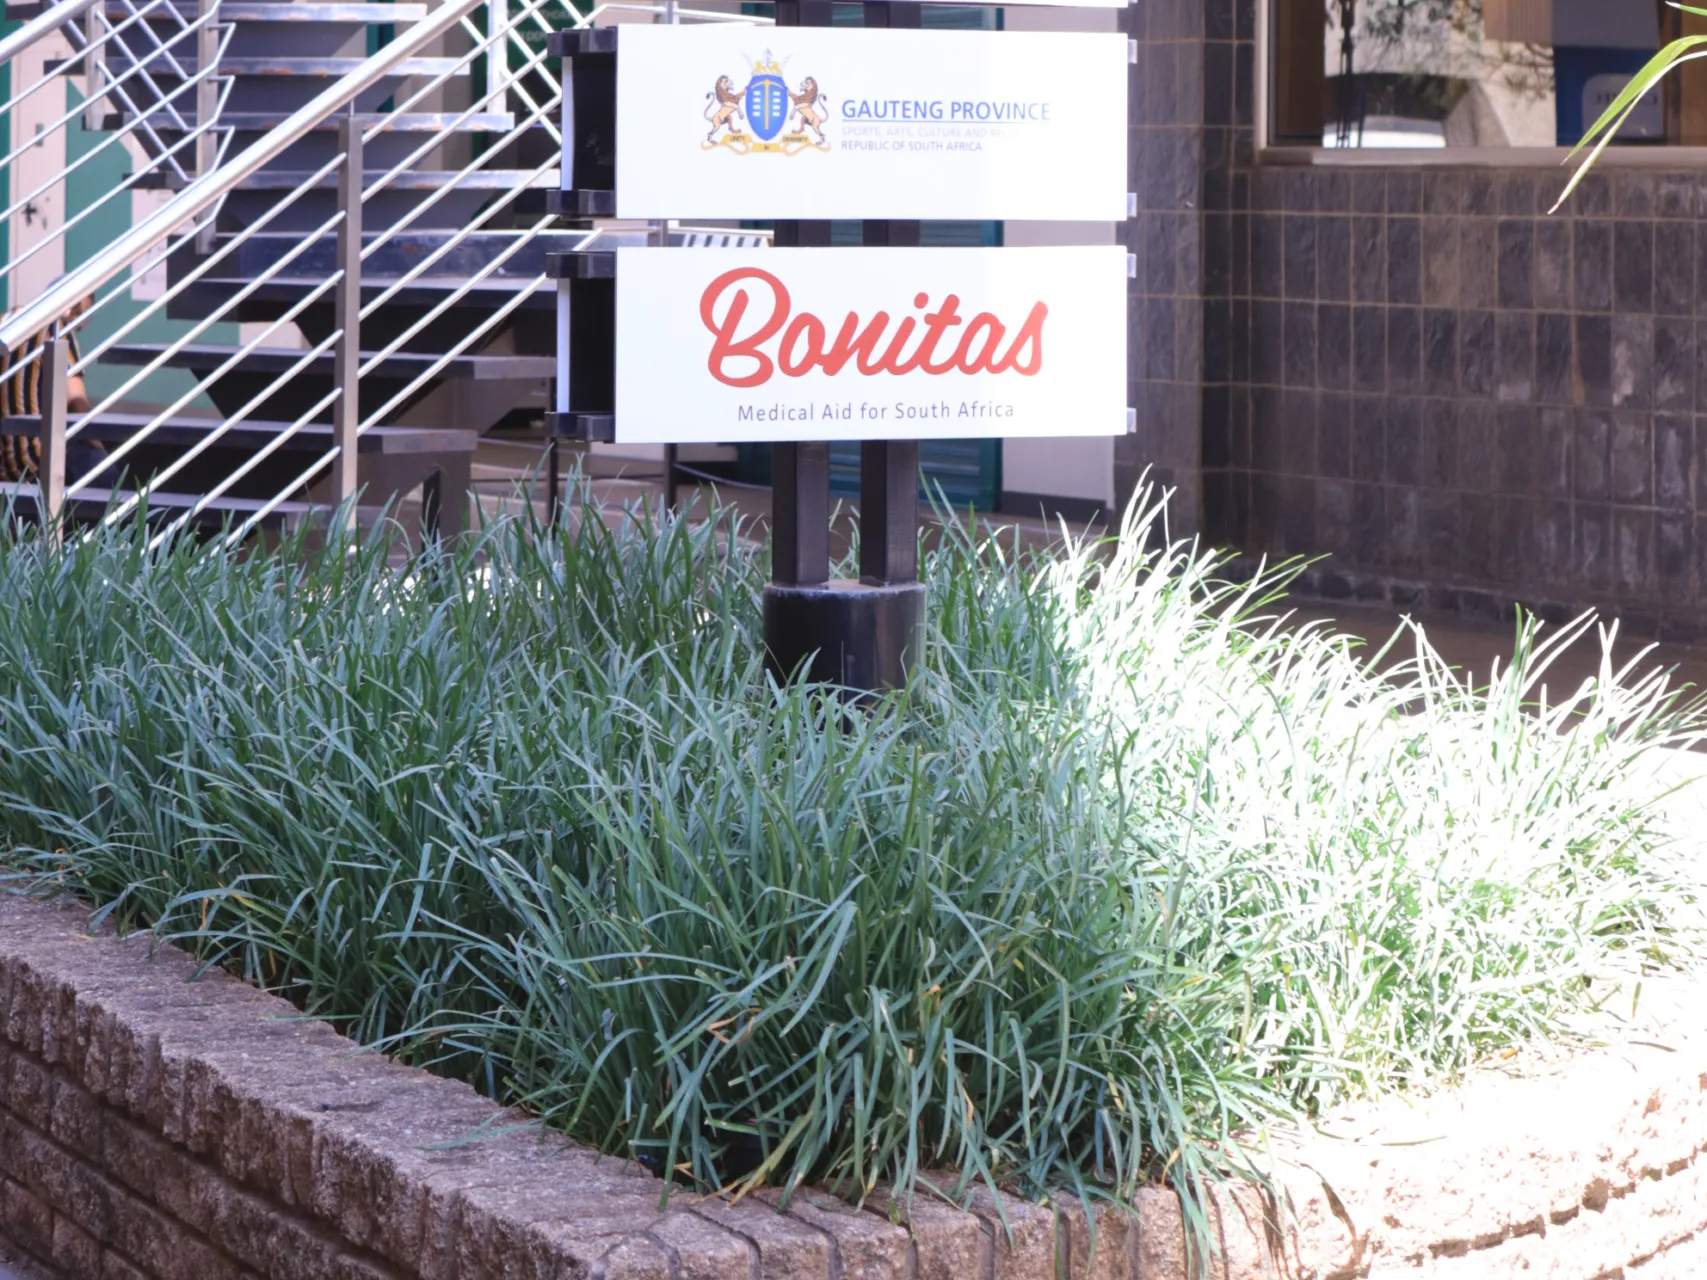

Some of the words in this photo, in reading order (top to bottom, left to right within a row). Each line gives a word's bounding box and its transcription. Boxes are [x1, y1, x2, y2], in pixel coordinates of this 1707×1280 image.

[841, 99, 943, 120] GAUTENG
[951, 101, 1051, 121] PROVINCE
[965, 128, 987, 138] AND
[841, 140, 889, 151] REPUBLIC
[892, 141, 905, 151] OF
[908, 141, 943, 151] SOUTH
[946, 141, 983, 151] AFRICA
[699, 266, 1049, 389] Bonitas
[738, 403, 814, 423] Medical
[821, 402, 852, 421] Aid
[859, 402, 888, 420] for
[895, 401, 951, 420] South
[957, 400, 1015, 419] Africa
